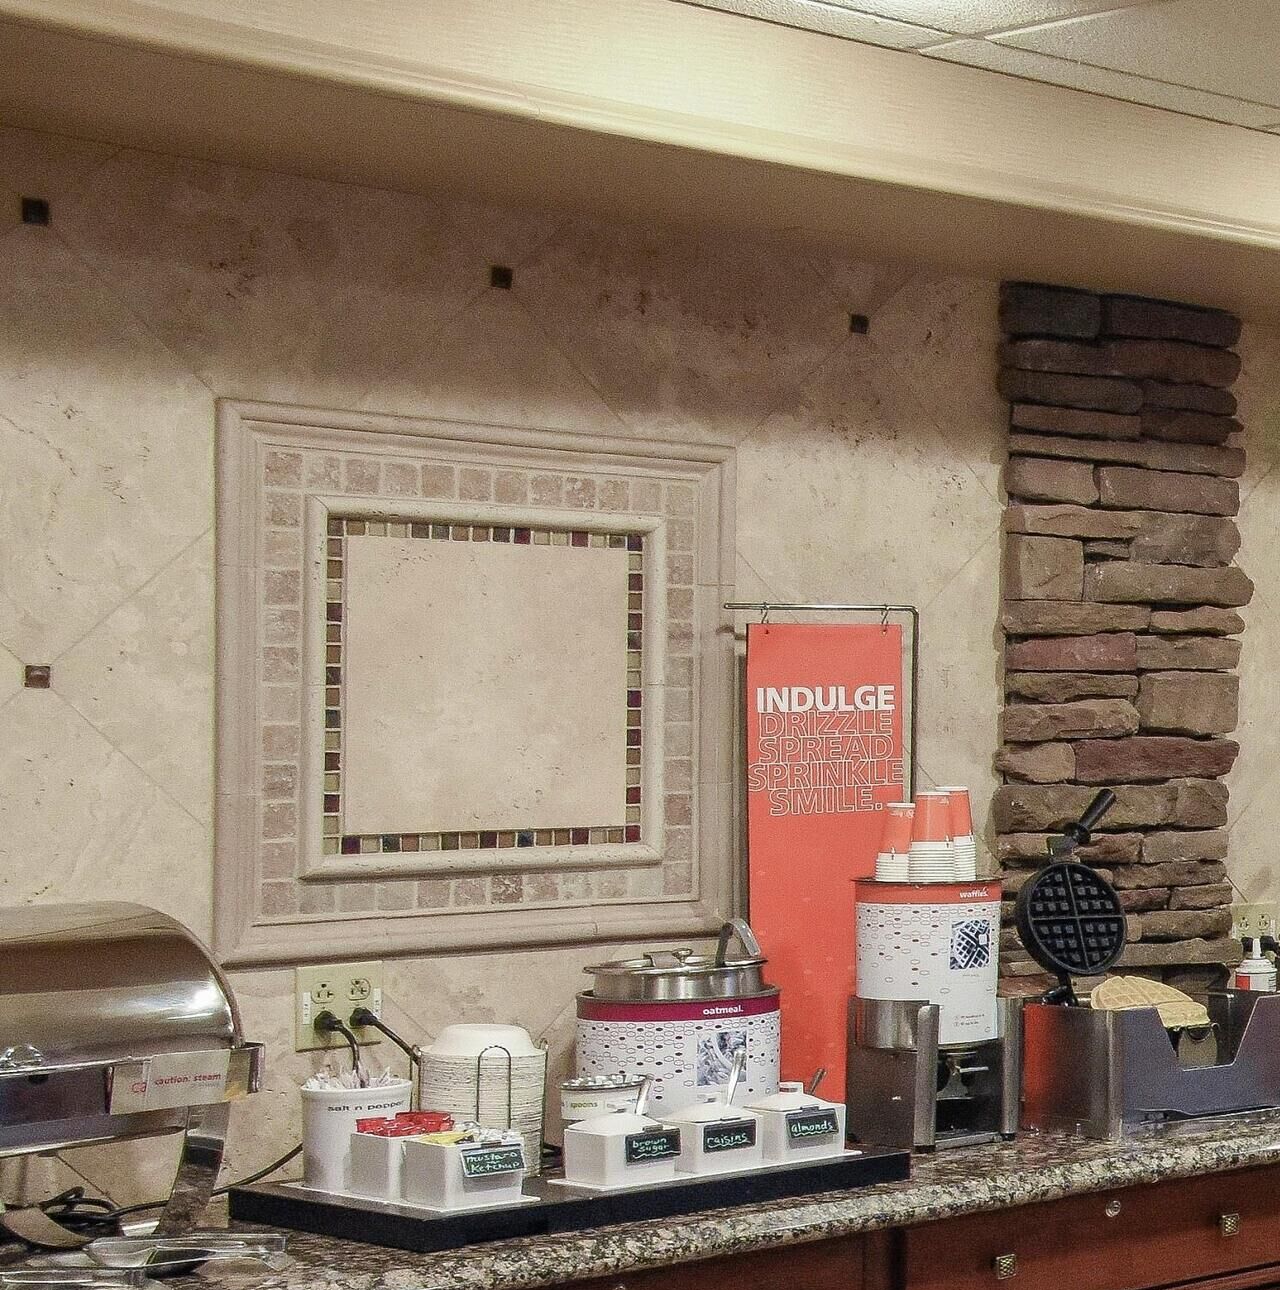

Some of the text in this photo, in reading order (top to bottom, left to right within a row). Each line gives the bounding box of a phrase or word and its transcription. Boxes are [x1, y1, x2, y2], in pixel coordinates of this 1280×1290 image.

[757, 685, 895, 712] INDULGE
[759, 709, 893, 738] DRIZZLE
[759, 734, 894, 764] SPREAD
[748, 758, 904, 791] SPRINKLE
[770, 784, 883, 816] SMILE.
[193, 1072, 222, 1082] steam
[327, 1104, 350, 1112] salt
[790, 1120, 834, 1133] almonds
[632, 1137, 667, 1148] brown
[706, 1131, 749, 1145] raisins
[638, 1144, 670, 1154] sugar
